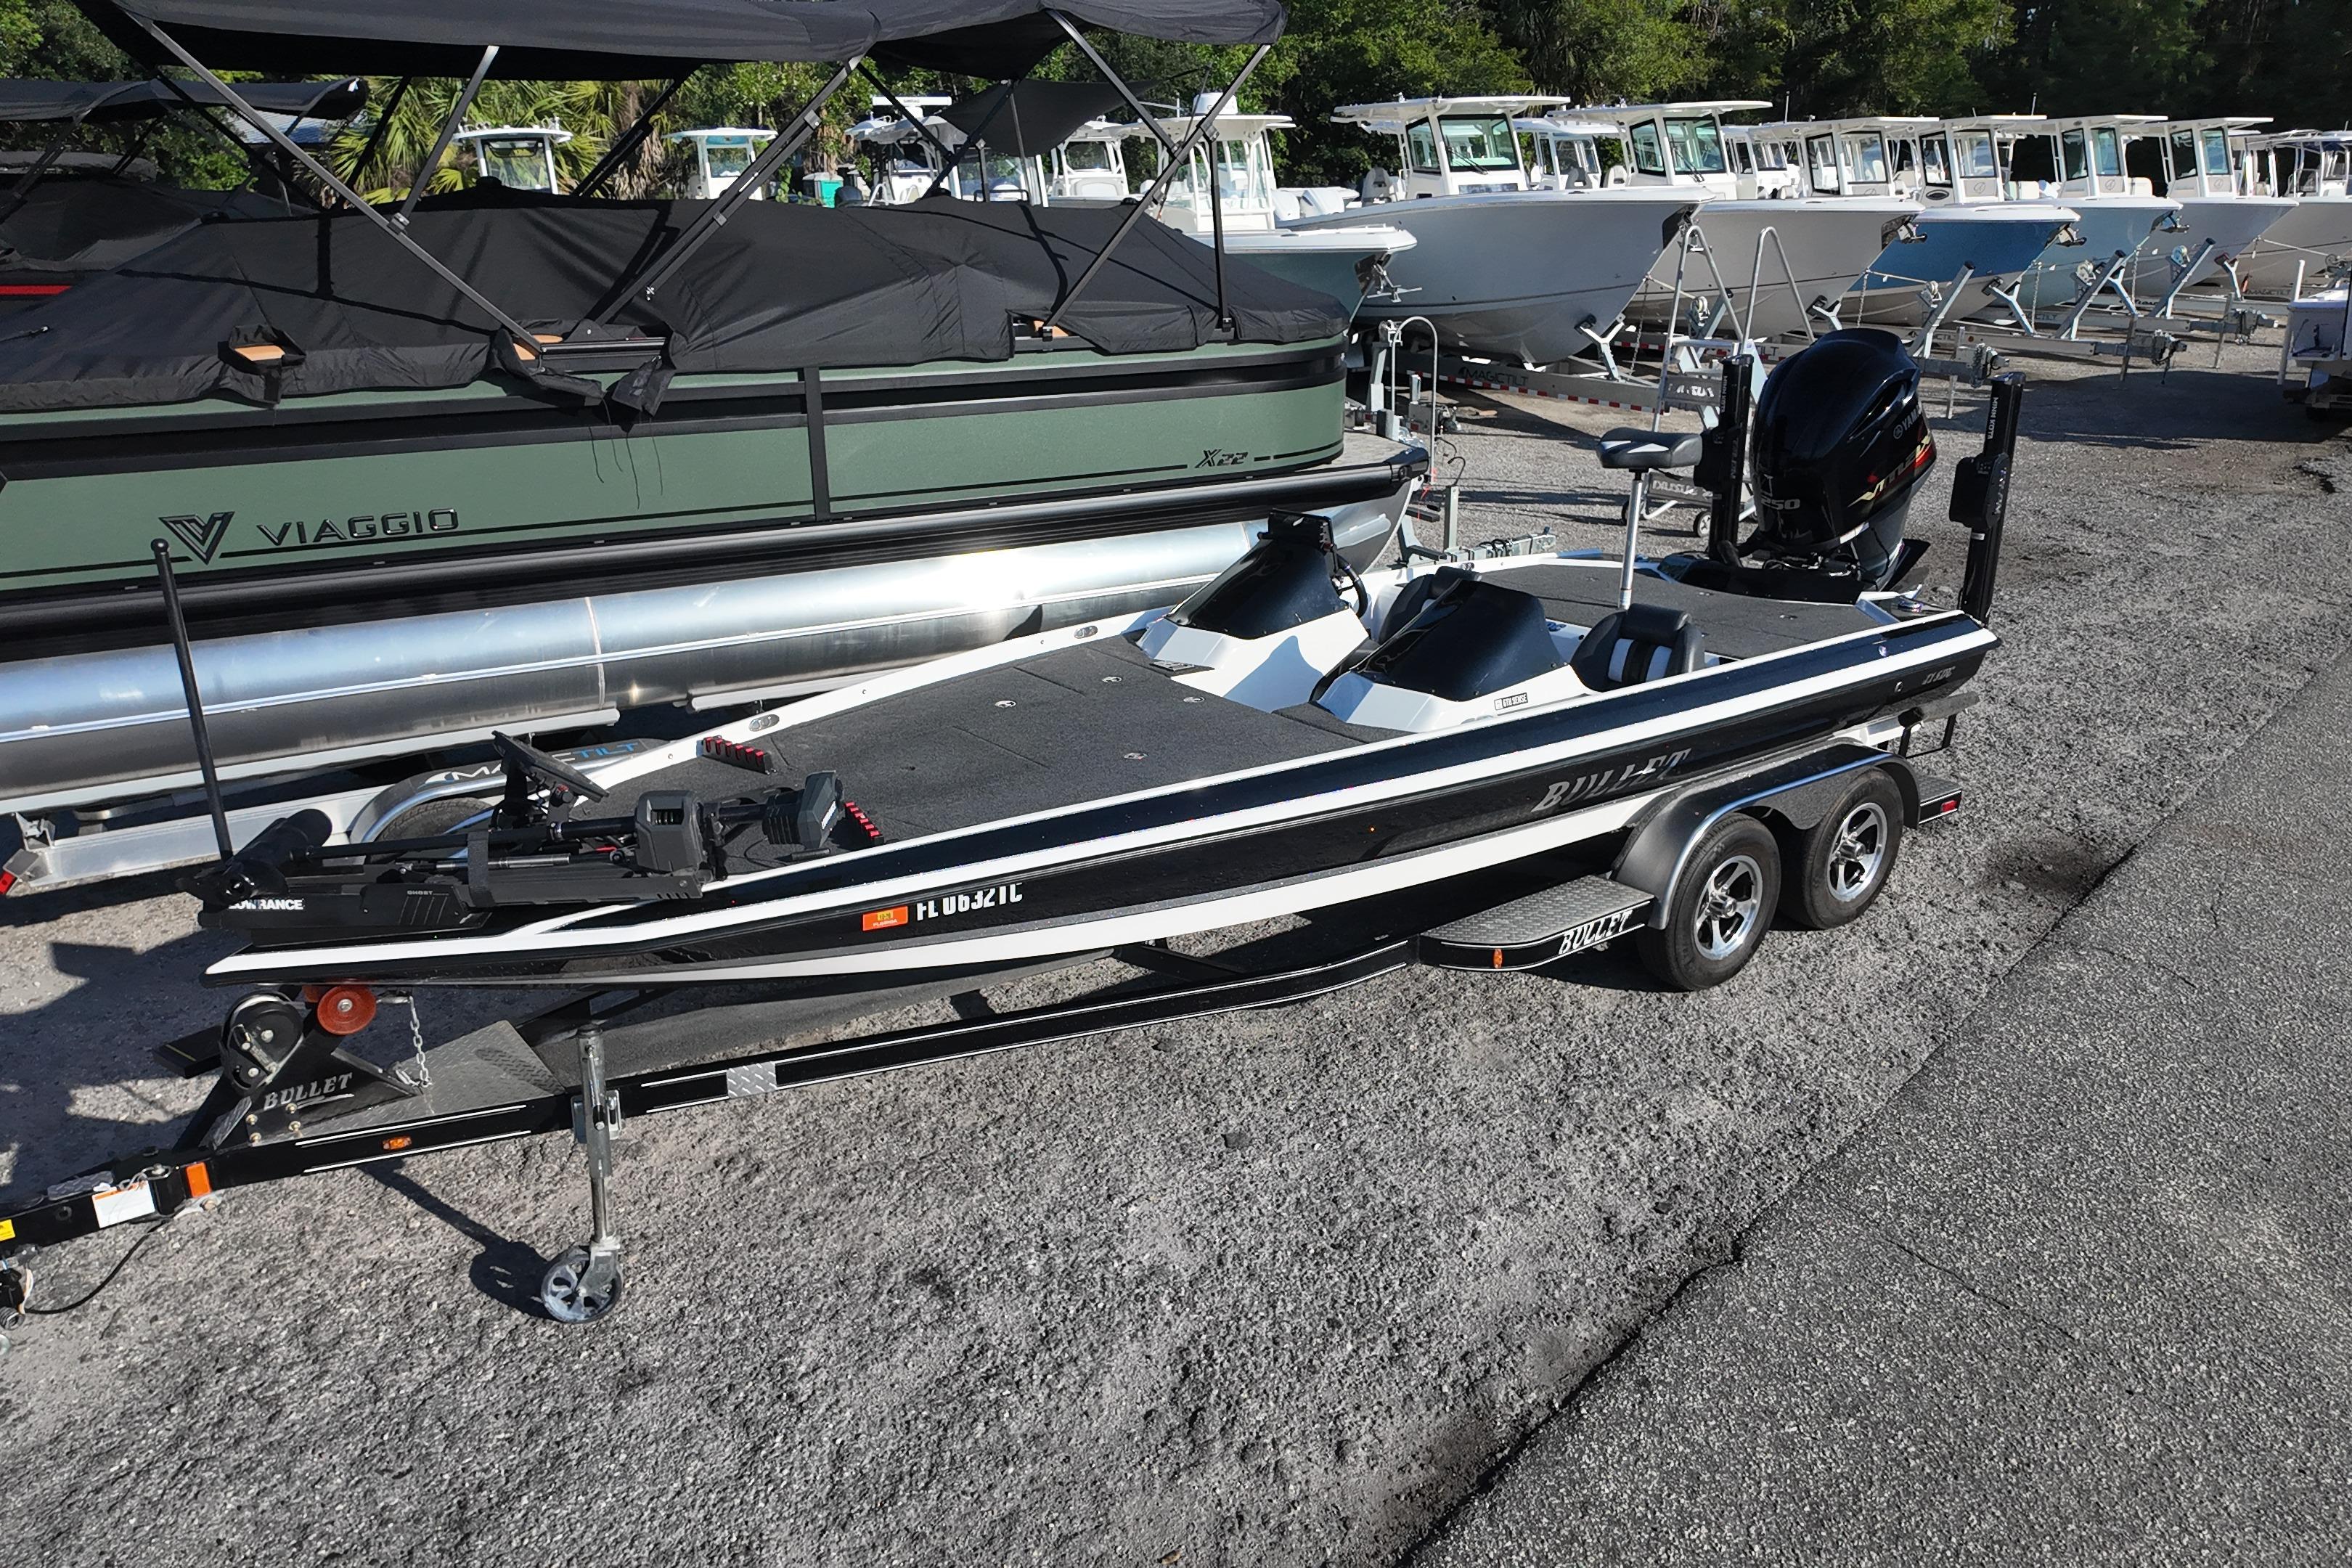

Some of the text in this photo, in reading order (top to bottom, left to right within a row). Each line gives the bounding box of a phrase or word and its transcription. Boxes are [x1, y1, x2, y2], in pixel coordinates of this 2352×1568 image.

[1987, 397, 1999, 440] MINN KOTA
[1194, 449, 1249, 468] X22
[1760, 498, 1800, 510] 250
[256, 508, 459, 546] VIAGGIO
[1530, 748, 1692, 812] BULLET
[1559, 910, 1633, 955] BULLET
[264, 1072, 353, 1111] BULLET
